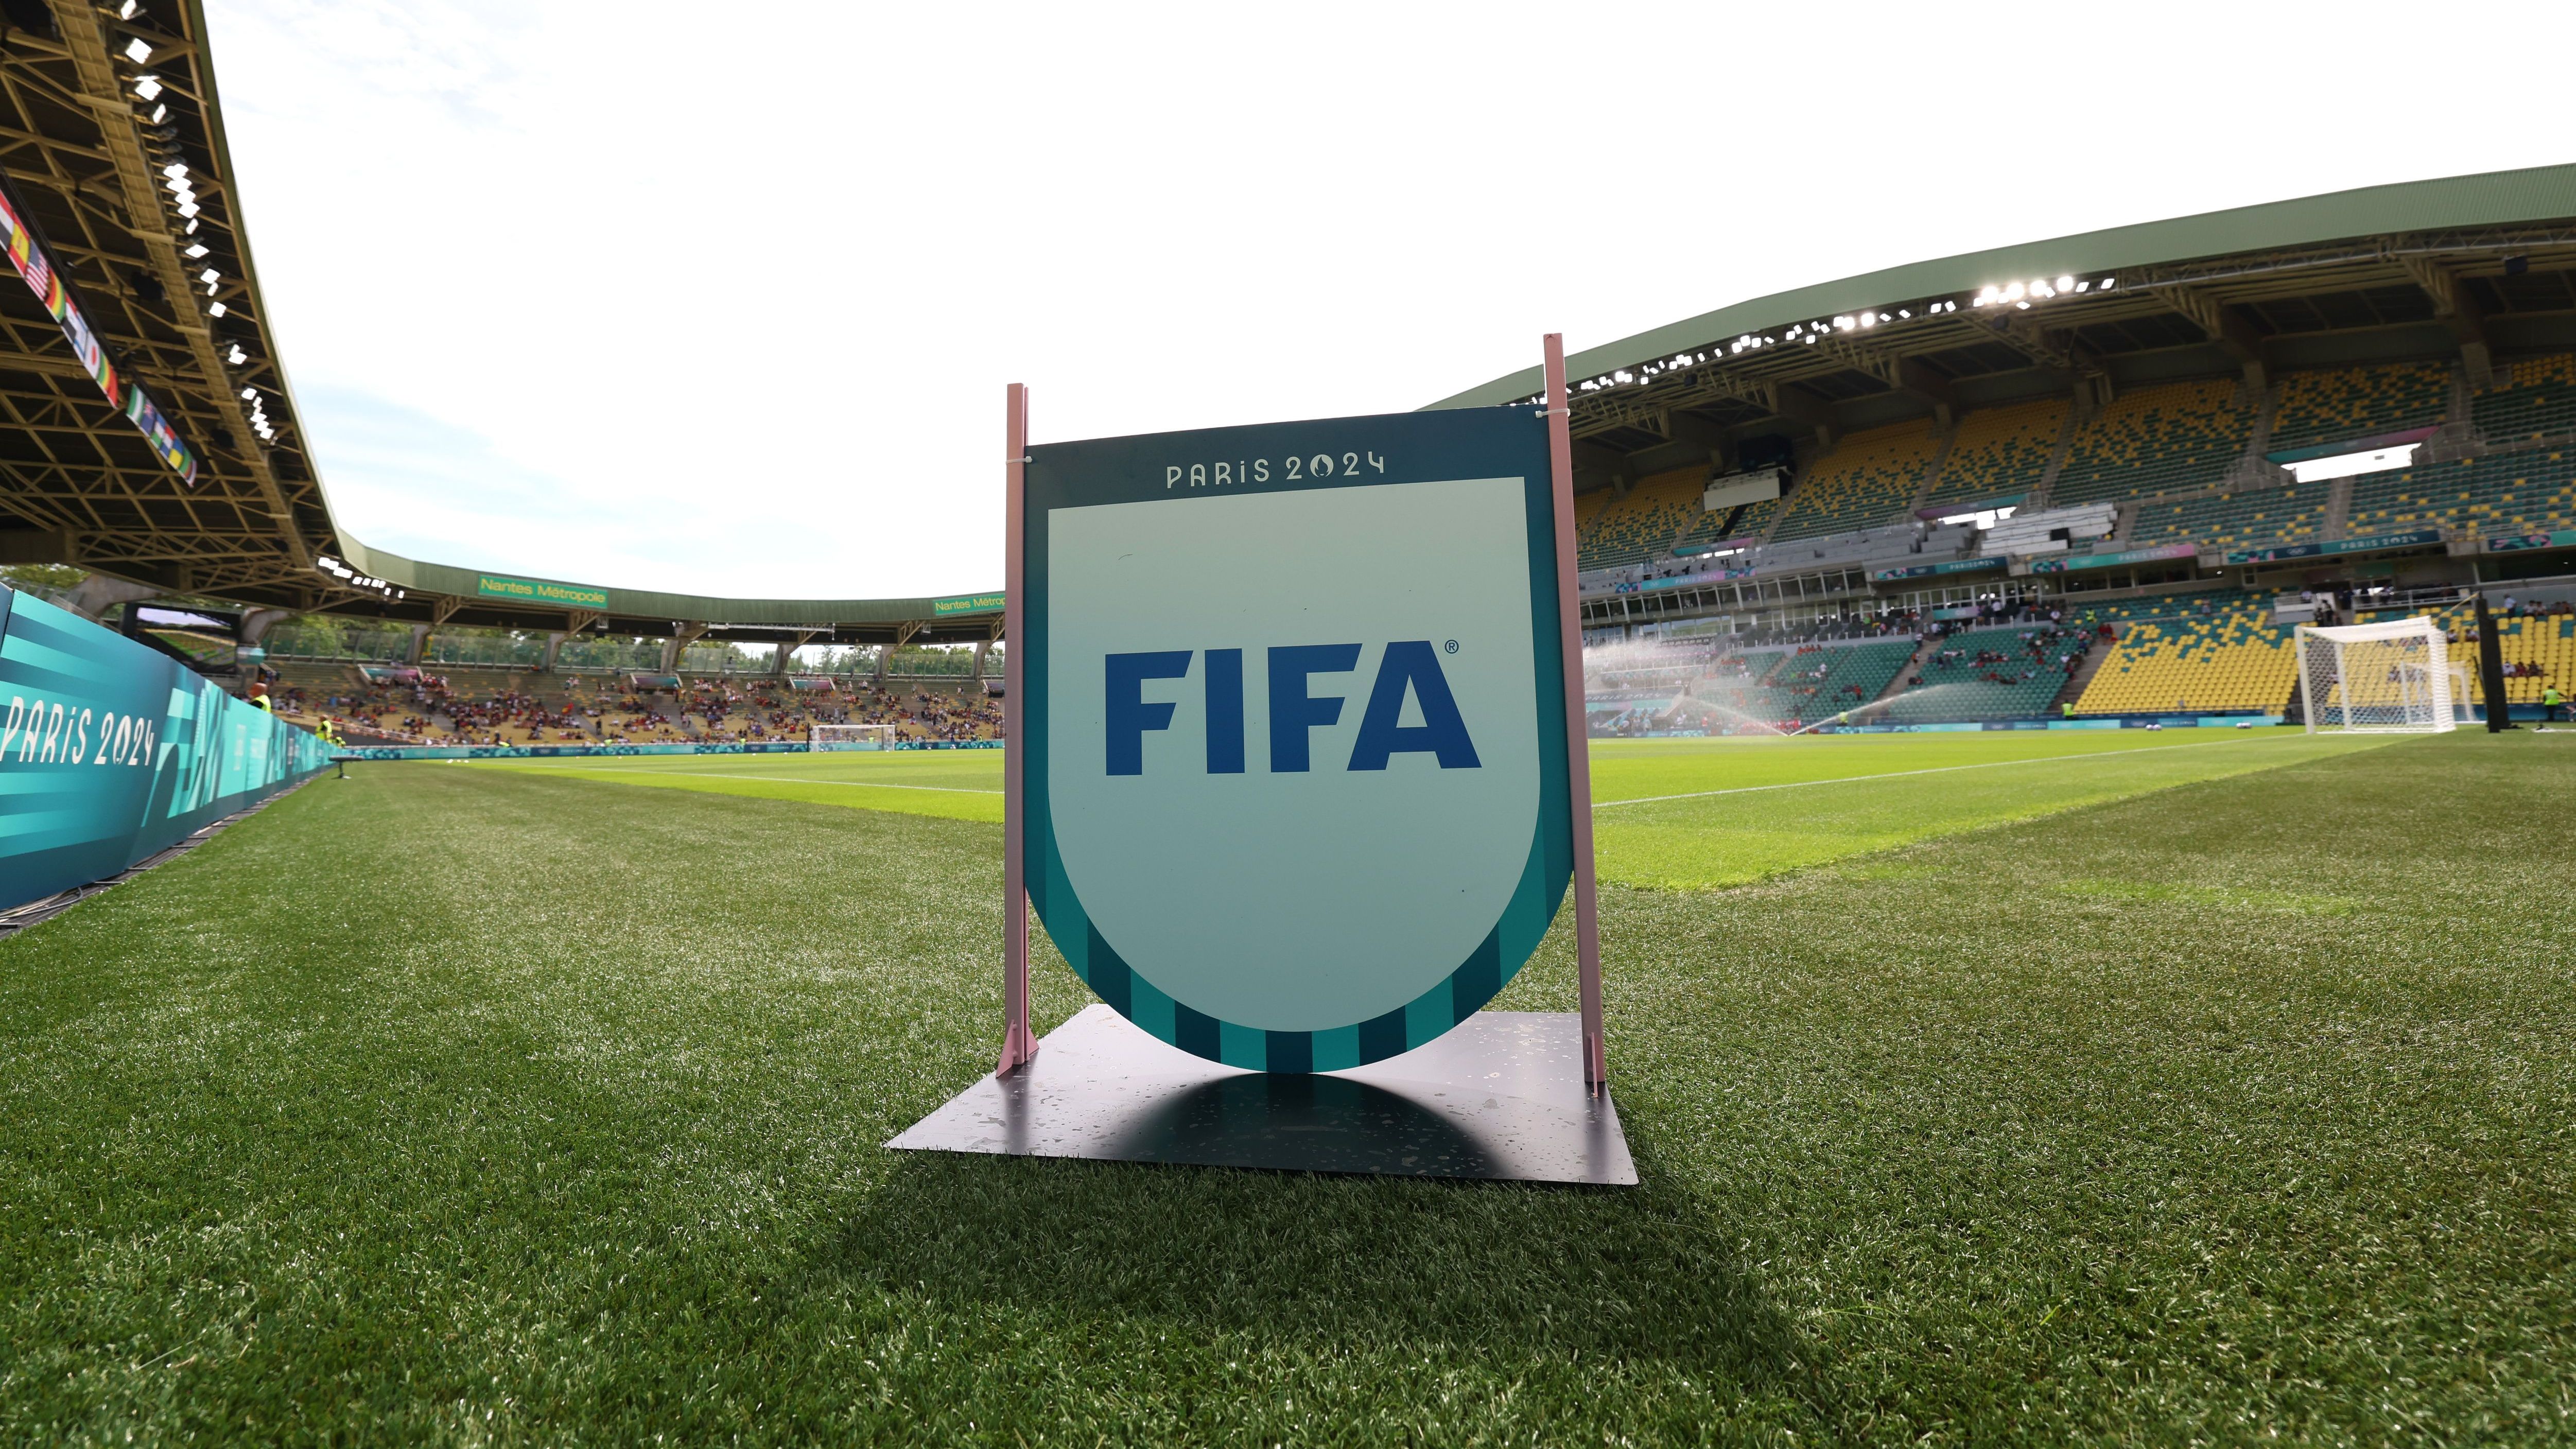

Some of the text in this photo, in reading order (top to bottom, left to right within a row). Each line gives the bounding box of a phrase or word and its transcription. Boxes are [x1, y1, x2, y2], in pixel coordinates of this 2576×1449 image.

[1285, 451, 1384, 480] 2024
[480, 578, 606, 603] Nantes Métropole
[935, 600, 971, 611] Nantes
[93, 712, 154, 766] 2024
